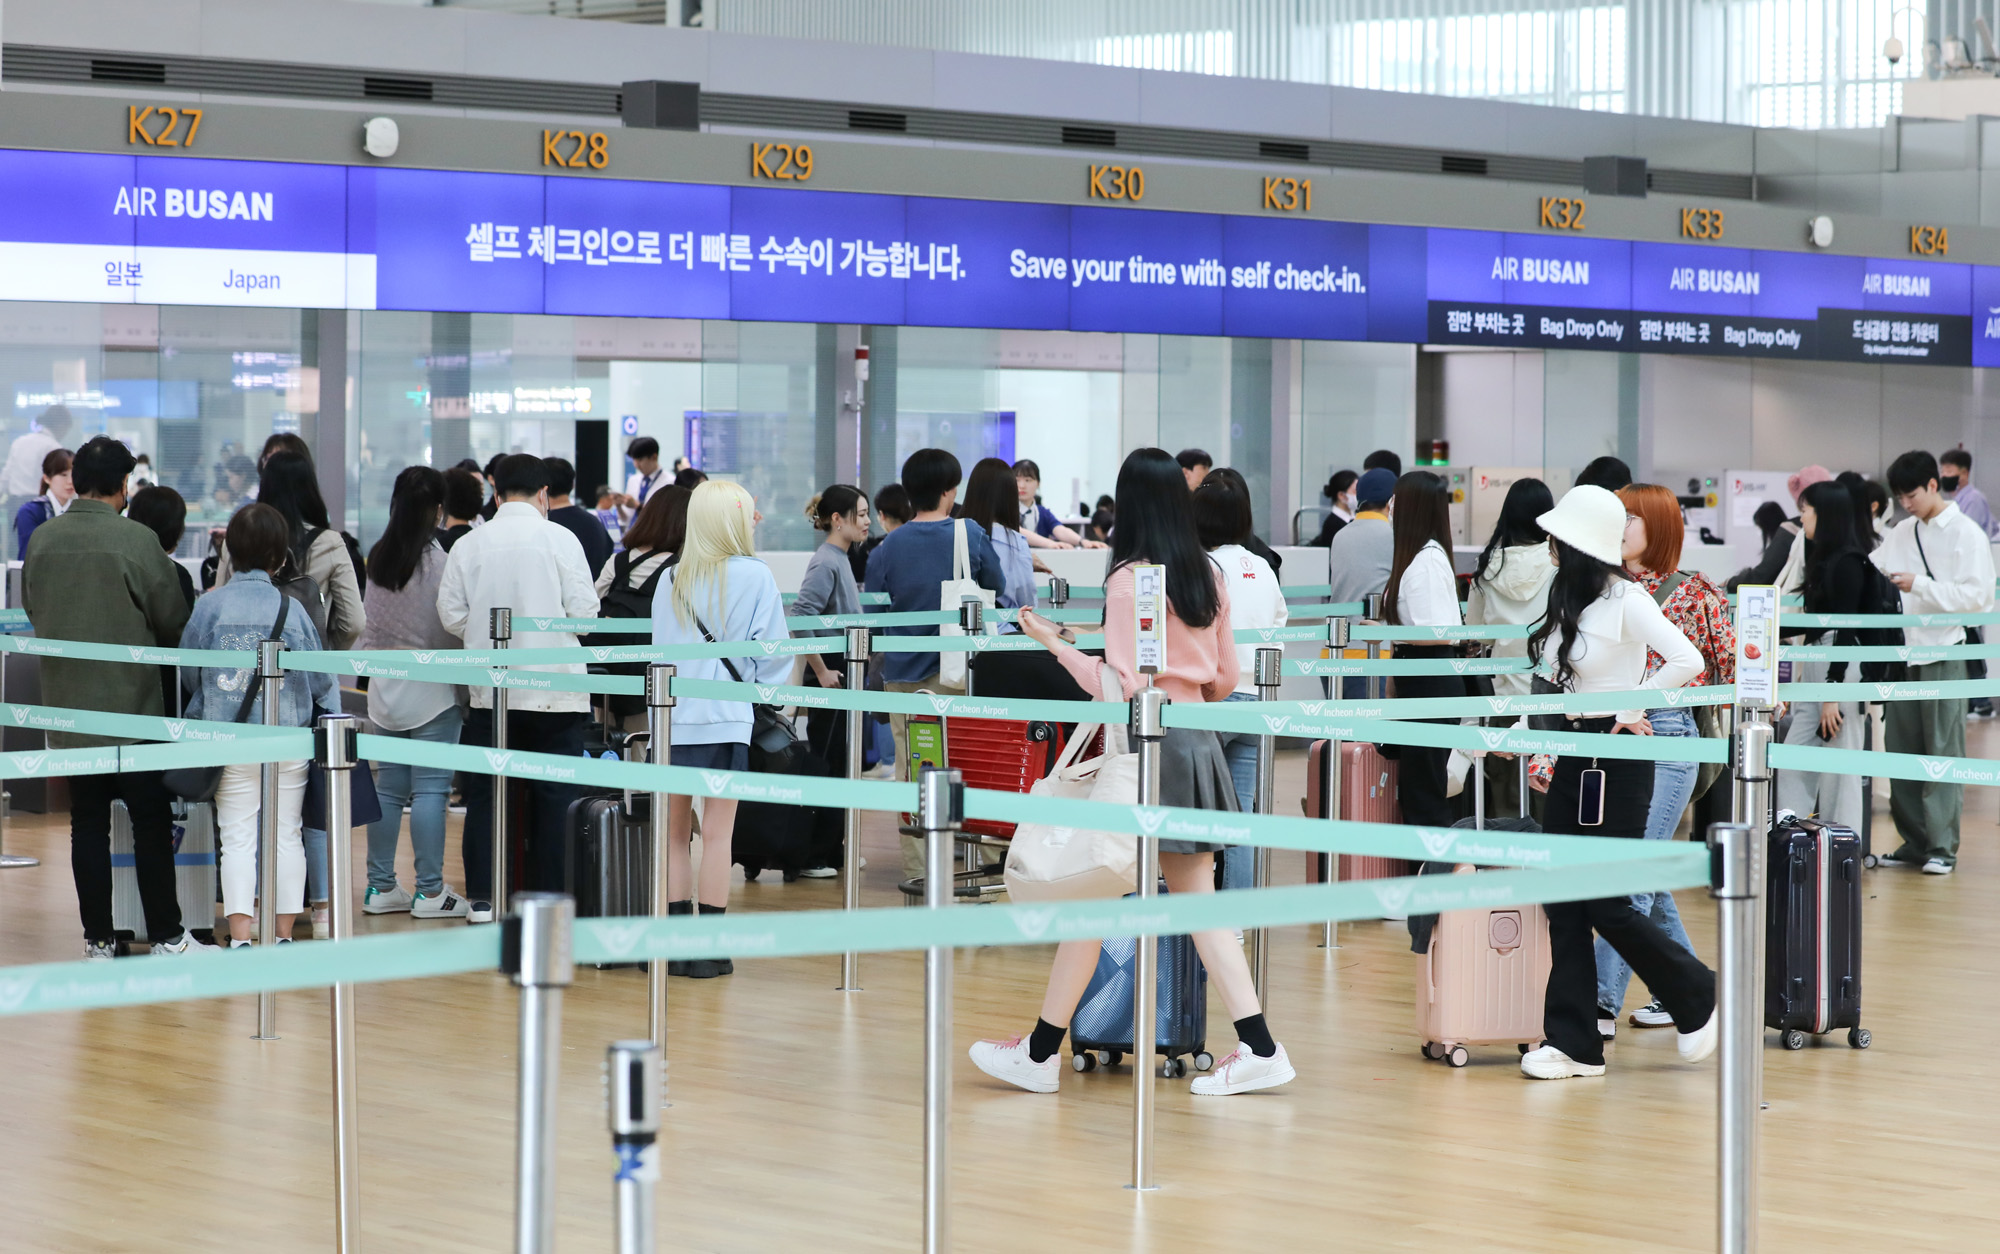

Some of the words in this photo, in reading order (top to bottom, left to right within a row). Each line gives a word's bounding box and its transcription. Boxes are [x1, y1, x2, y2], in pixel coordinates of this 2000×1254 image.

[128, 105, 203, 148] K27
[543, 129, 610, 169] K28
[752, 142, 814, 181] K29
[1089, 164, 1145, 201] K30
[1263, 176, 1313, 211] K31
[113, 186, 158, 218] AIR
[164, 187, 274, 222] BUSAN
[1540, 197, 1586, 229] K32
[1681, 208, 1725, 239] K33
[1910, 226, 1949, 255] K34
[465, 222, 522, 262] 셀프
[527, 225, 663, 266] 체크인으로
[668, 231, 694, 270] 더
[701, 233, 753, 271] 빠른
[758, 235, 833, 275] 수속이
[839, 239, 966, 281] 가능합니다.
[104, 261, 143, 287] 일본
[1010, 249, 1067, 280] Save
[1072, 259, 1125, 287] your
[1128, 255, 1176, 285] time
[1181, 258, 1226, 287] with
[1231, 261, 1271, 289] self
[1274, 263, 1367, 294] check-in.
[1491, 257, 1519, 281] AIR
[1522, 258, 1589, 285] BUSAN
[223, 268, 281, 293] Japan
[1670, 268, 1695, 291] AIR
[1698, 269, 1760, 295] BUSAN
[1863, 273, 1882, 294] AIR
[1883, 275, 1930, 297] BUSAN
[1447, 311, 1472, 333] 짐만
[1474, 312, 1510, 335] 부치는
[1512, 314, 1525, 335] 곳
[1540, 317, 1564, 339] Bag
[1566, 318, 1595, 340] Drop
[1596, 320, 1624, 342] Only
[1639, 320, 1662, 341] 짐만
[1663, 321, 1697, 343] 부치는
[1698, 322, 1711, 343] 곳
[1724, 326, 1746, 348] Bag
[1747, 327, 1774, 349] Drop
[1775, 328, 1801, 350] Only
[1852, 319, 1890, 342] 도심공항
[1911, 322, 1940, 344] 카운터
[1242, 572, 1256, 580] NYC
[552, 622, 575, 631] Incheon
[576, 622, 597, 633] Airport
[836, 619, 857, 627] Incheon
[858, 618, 877, 627] Airport
[1275, 632, 1296, 640] Incheon
[1297, 631, 1316, 640] Airport
[1447, 629, 1468, 638] Incheon
[1469, 629, 1486, 638] Airport
[780, 643, 805, 653] Incheon
[806, 643, 829, 654] Airport
[990, 641, 1014, 649] Incheon
[1015, 640, 1036, 650] Airport
[435, 654, 463, 665] Incheon
[465, 654, 490, 665] Airport
[612, 650, 637, 660] Incheon
[638, 650, 664, 661] Airport
[366, 665, 388, 676] Incheon
[388, 667, 408, 678] Airport
[1315, 664, 1338, 673] Incheon
[1339, 664, 1363, 674] Airport
[1468, 663, 1490, 672] Incheon
[1491, 663, 1513, 673] Airport
[506, 676, 529, 687] Incheon
[530, 678, 551, 689] Airport
[777, 692, 803, 703] Incheon
[805, 693, 829, 706] Airport
[1683, 693, 1708, 703] Incheon
[1709, 692, 1732, 704] Airport
[1895, 688, 1918, 698] Incheon
[1919, 688, 1940, 699] Airport
[952, 703, 981, 715] Incheon
[982, 704, 1009, 717] Airport
[1324, 706, 1353, 718] Incheon
[1355, 706, 1382, 719] Airport
[1510, 701, 1538, 712] Incheon
[1540, 701, 1565, 713] Airport
[29, 714, 52, 727] Incheon
[53, 716, 75, 729] Airport
[185, 728, 211, 740] Incheon
[212, 730, 236, 742] Airport
[1289, 722, 1321, 735] Incheon
[1322, 725, 1353, 738] Airport
[1507, 737, 1542, 750] Incheon
[1544, 739, 1577, 753] Airport
[48, 755, 92, 771] Incheon
[94, 755, 135, 771] Airport
[510, 761, 543, 775] Incheon
[545, 764, 575, 779] Airport
[1952, 767, 1994, 782] Incheon
[730, 783, 766, 796] Incheon
[769, 785, 802, 799] Airport
[1166, 818, 1210, 834] Incheon
[1212, 821, 1251, 839] Airport
[1456, 842, 1503, 860] Incheon
[1506, 844, 1551, 864] Airport
